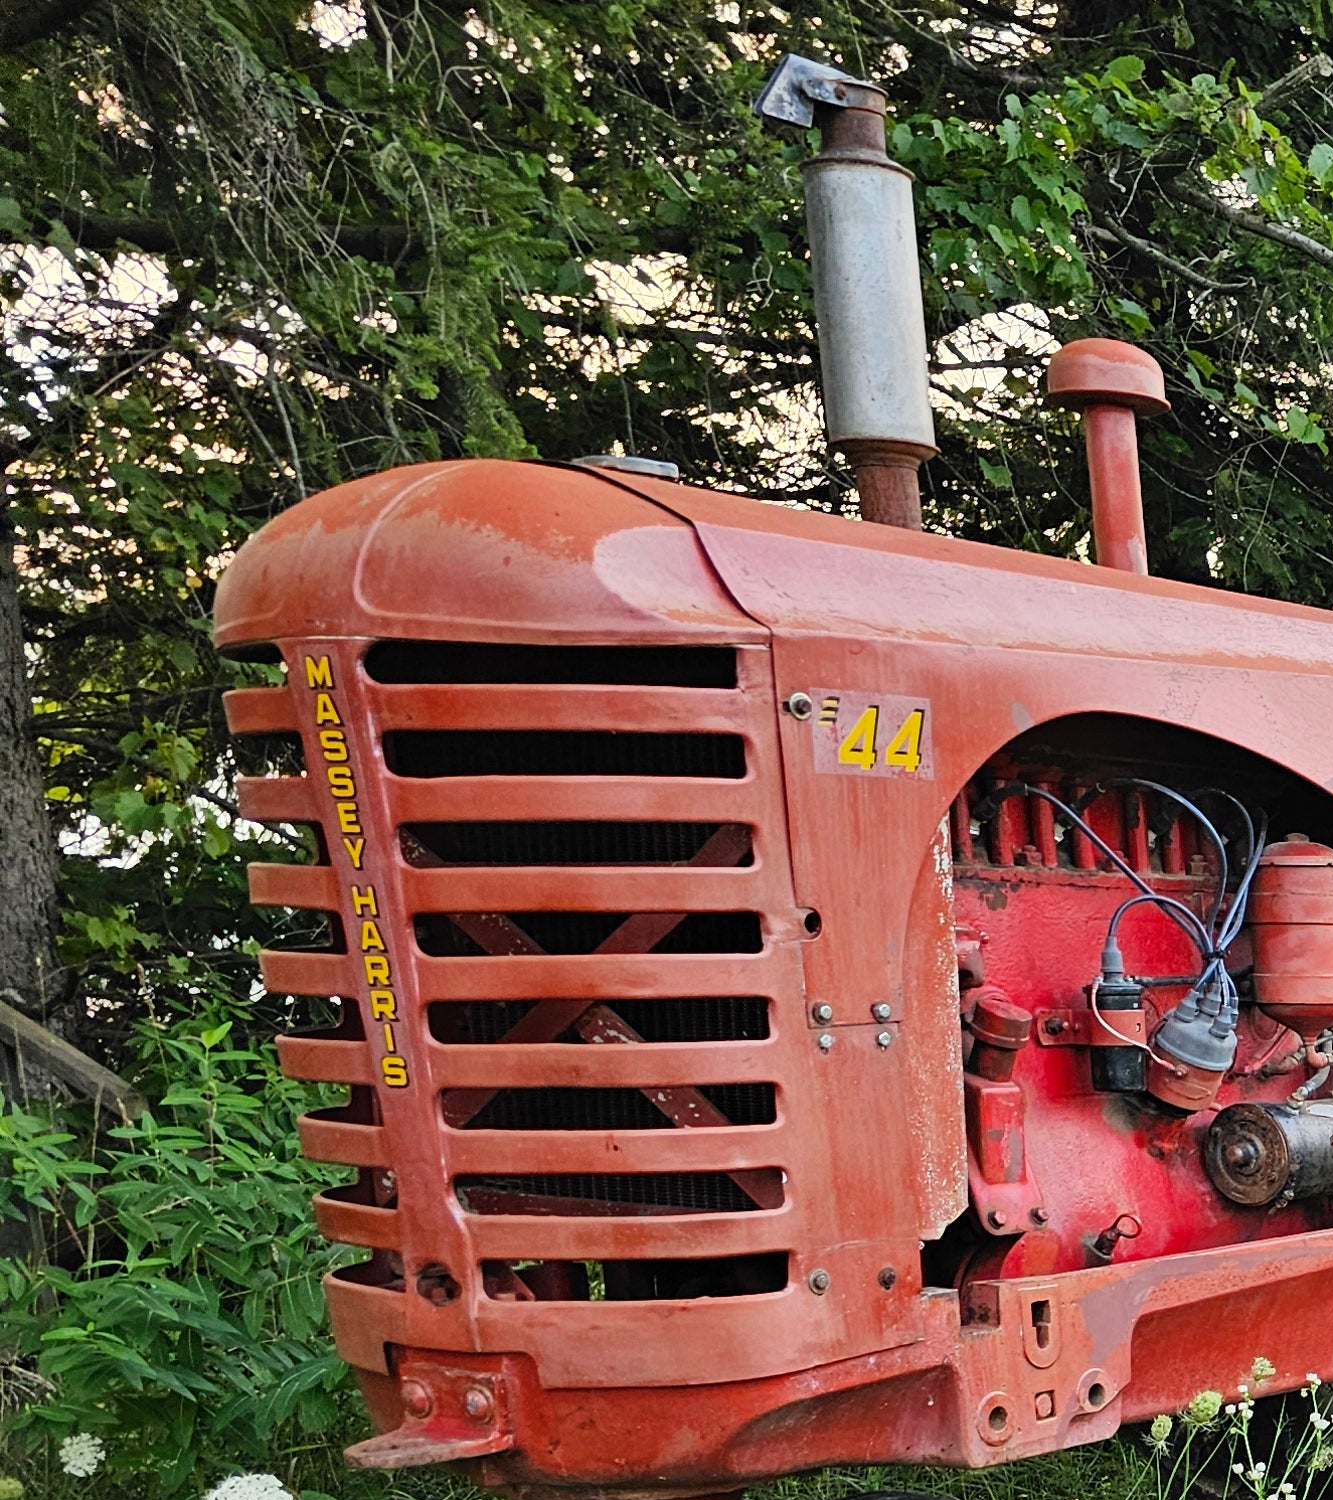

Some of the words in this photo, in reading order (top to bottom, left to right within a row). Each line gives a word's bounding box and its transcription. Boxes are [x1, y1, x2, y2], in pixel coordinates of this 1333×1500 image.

[838, 705, 925, 772] 44
[305, 655, 366, 871] MASSEY
[350, 885, 409, 1089] HARRIS
